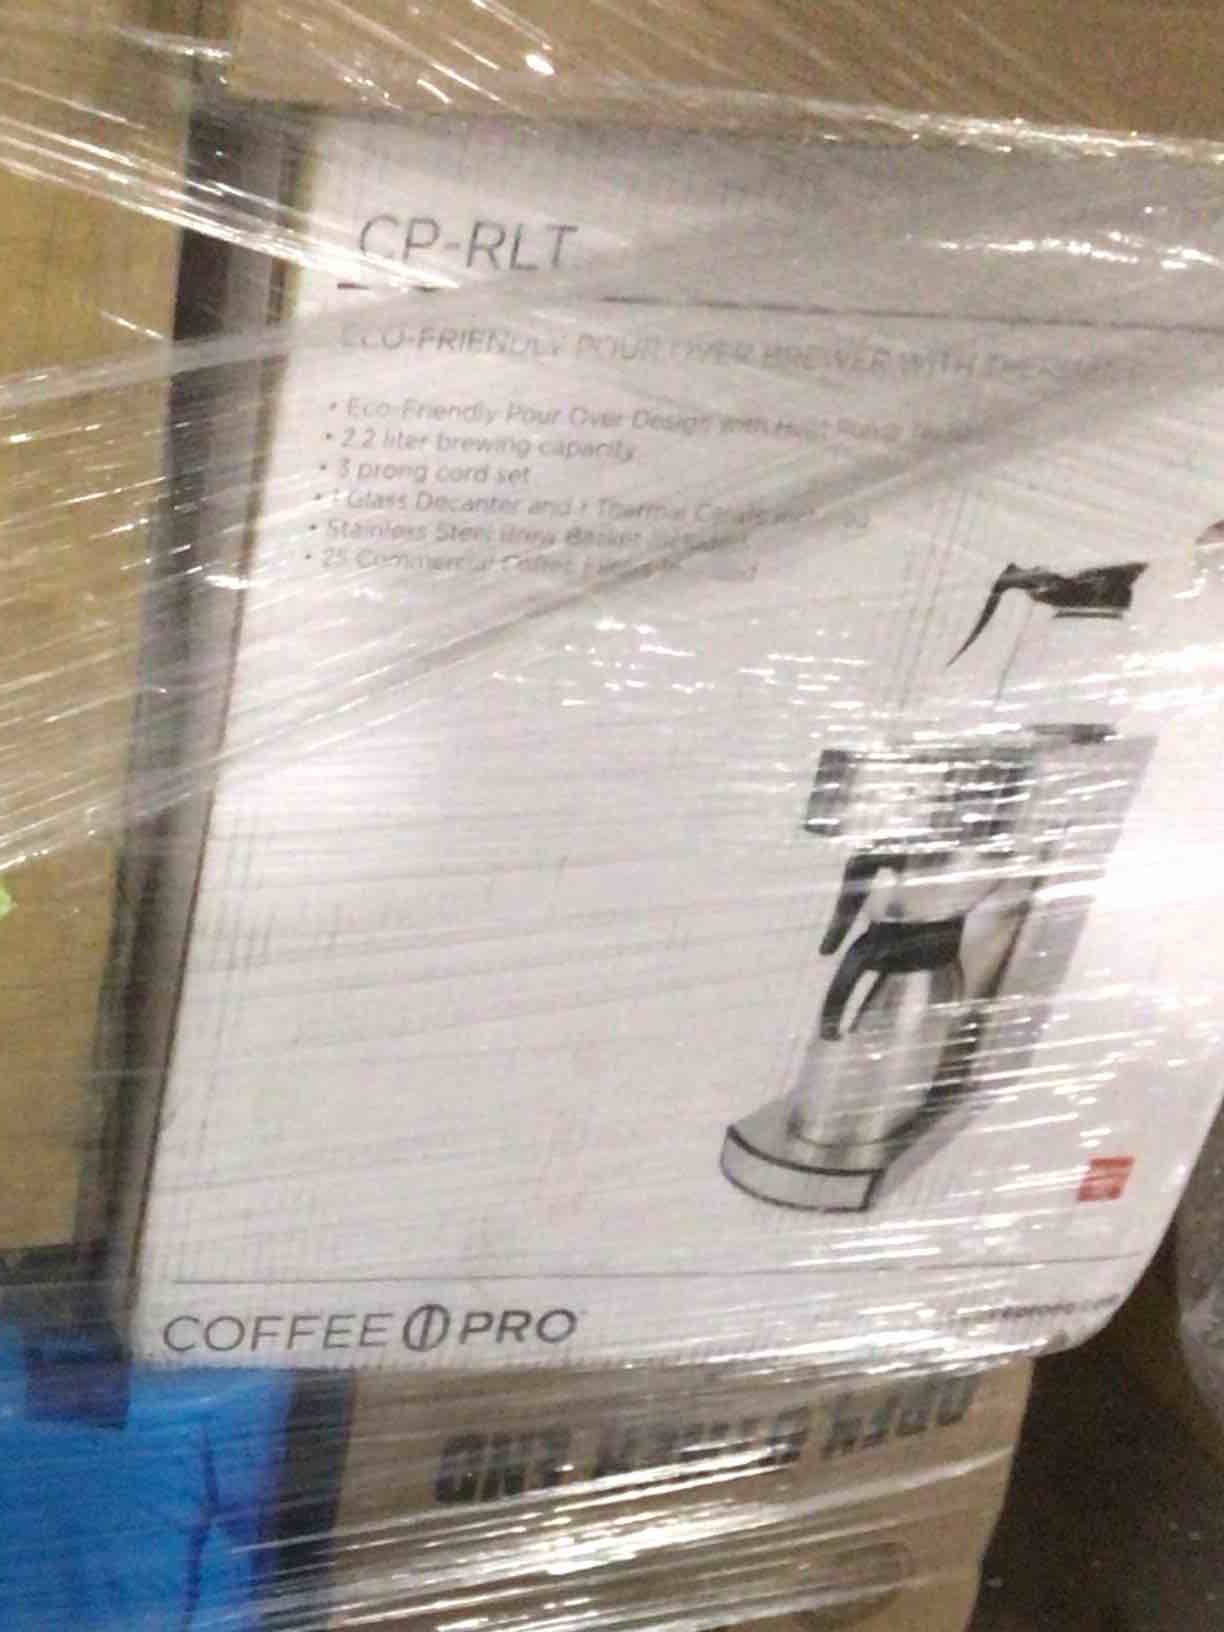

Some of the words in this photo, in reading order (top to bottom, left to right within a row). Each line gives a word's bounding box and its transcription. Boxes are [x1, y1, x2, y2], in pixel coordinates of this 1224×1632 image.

[359, 212, 579, 272] CP-RLT
[356, 462, 429, 486] prong
[435, 462, 489, 485] cord
[496, 465, 532, 486] set
[162, 1311, 393, 1354] COFFEE
[458, 1308, 577, 1346] PRO
